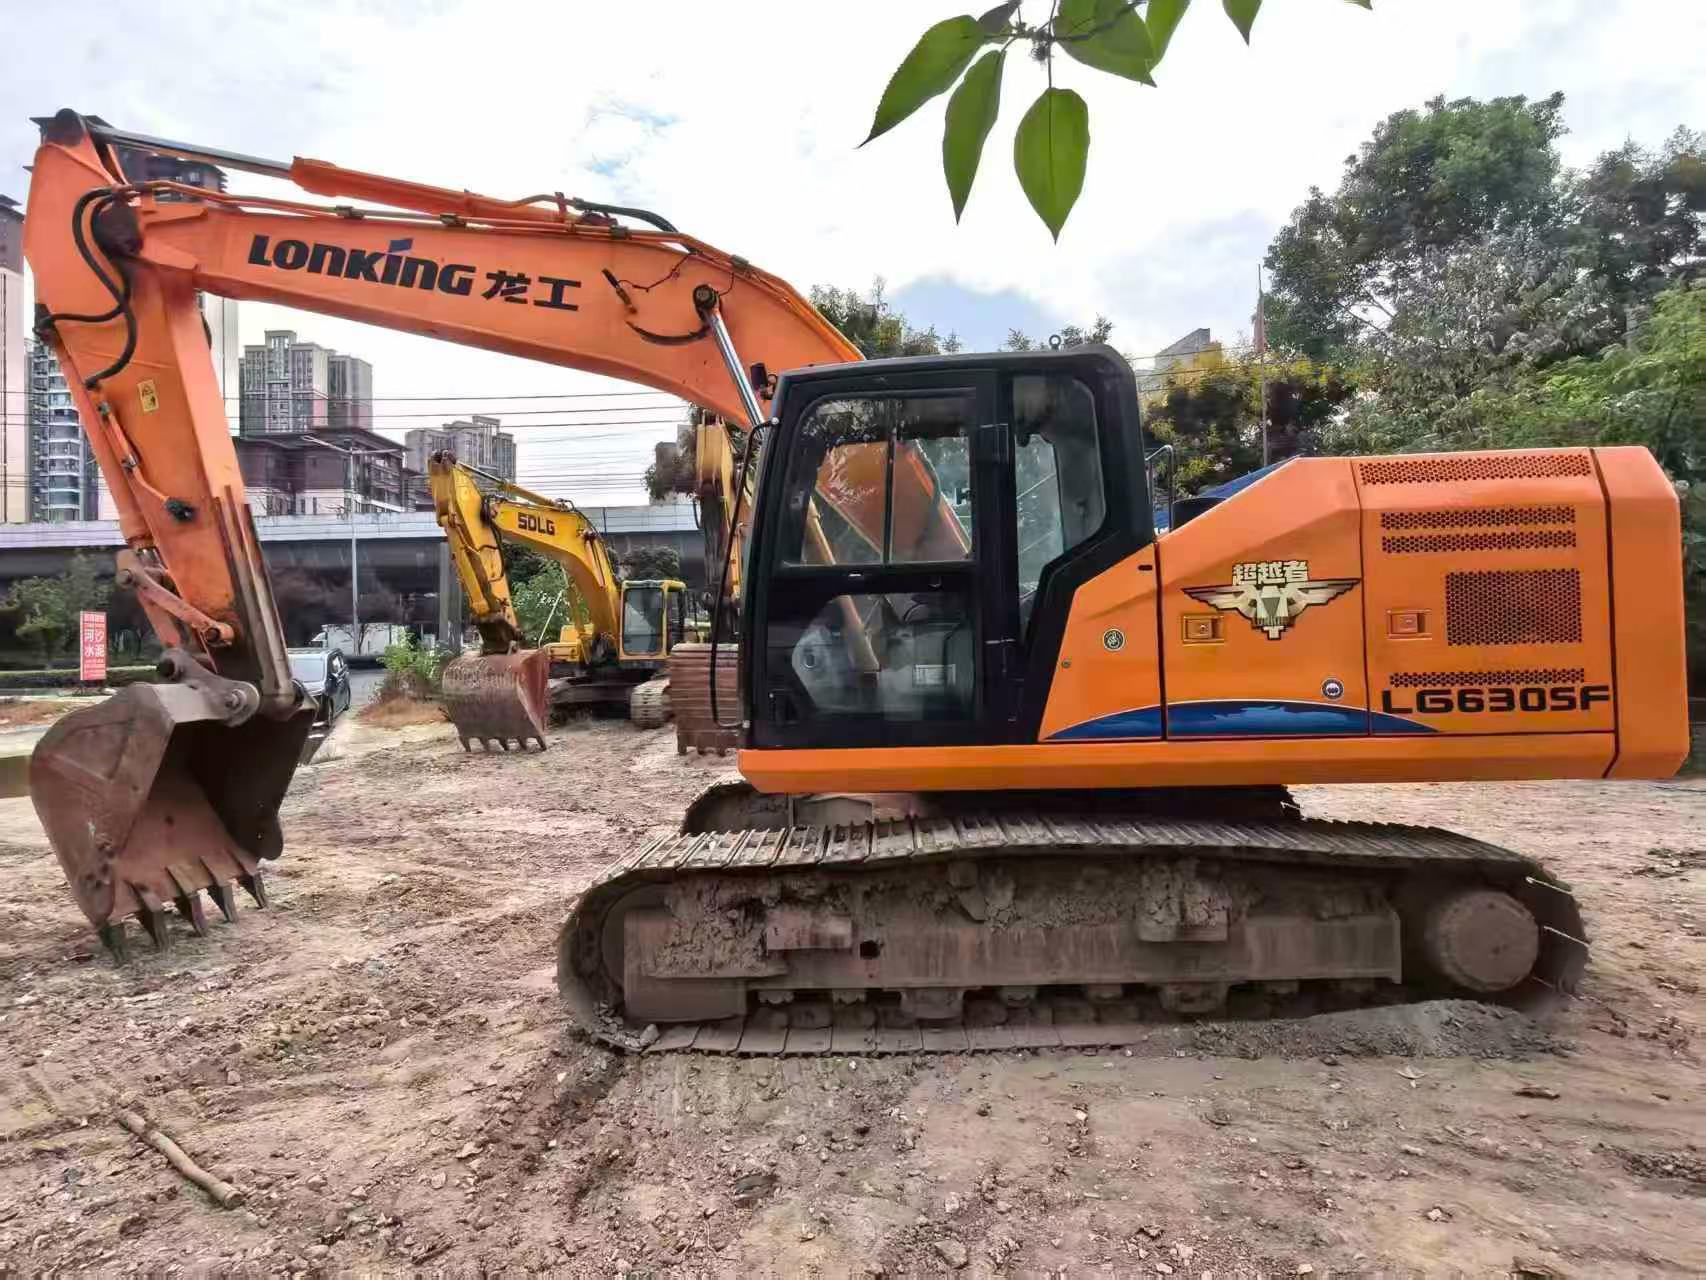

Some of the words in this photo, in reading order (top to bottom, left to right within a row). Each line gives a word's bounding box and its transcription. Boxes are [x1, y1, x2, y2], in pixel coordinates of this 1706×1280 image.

[481, 269, 582, 312] 龙工
[518, 511, 555, 536] SDLG
[1232, 560, 1309, 586] 超越者
[1382, 684, 1610, 715] LG630SF
